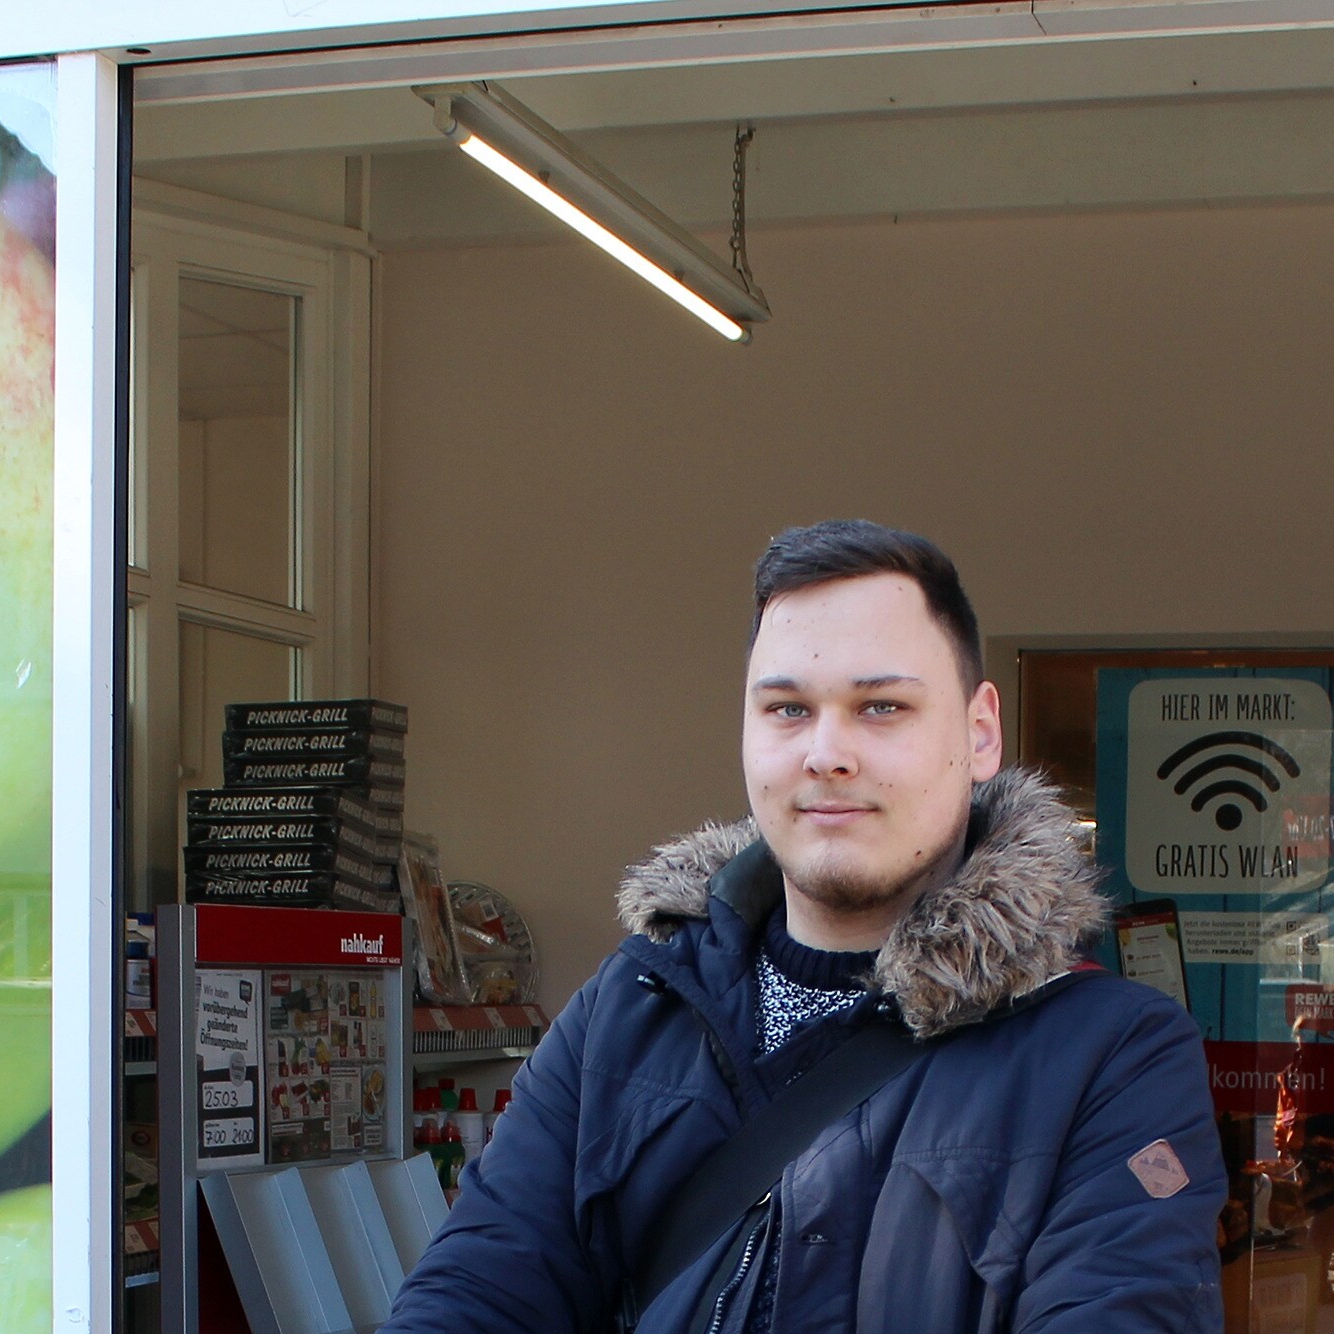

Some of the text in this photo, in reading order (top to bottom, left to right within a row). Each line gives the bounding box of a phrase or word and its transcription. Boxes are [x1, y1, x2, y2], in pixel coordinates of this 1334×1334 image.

[1161, 693, 1296, 722] HIER IM MARKT:
[247, 708, 348, 724] PICKNICK-GRILL
[244, 735, 346, 751] PICKNICK-GRILL
[244, 762, 345, 779] PICKNICK-GRILL
[209, 795, 314, 811] PICKNICK-GRILL
[208, 824, 315, 840] PICKNICK-GRILL
[205, 853, 311, 869] PICKNICK-GRILL
[1156, 844, 1299, 878] GRATIS WLAN
[205, 880, 309, 896] PICKNICK-GRILL
[340, 933, 383, 955] nahkauf
[203, 1001, 248, 1019] vorübergehend
[207, 1018, 238, 1033] geänderte
